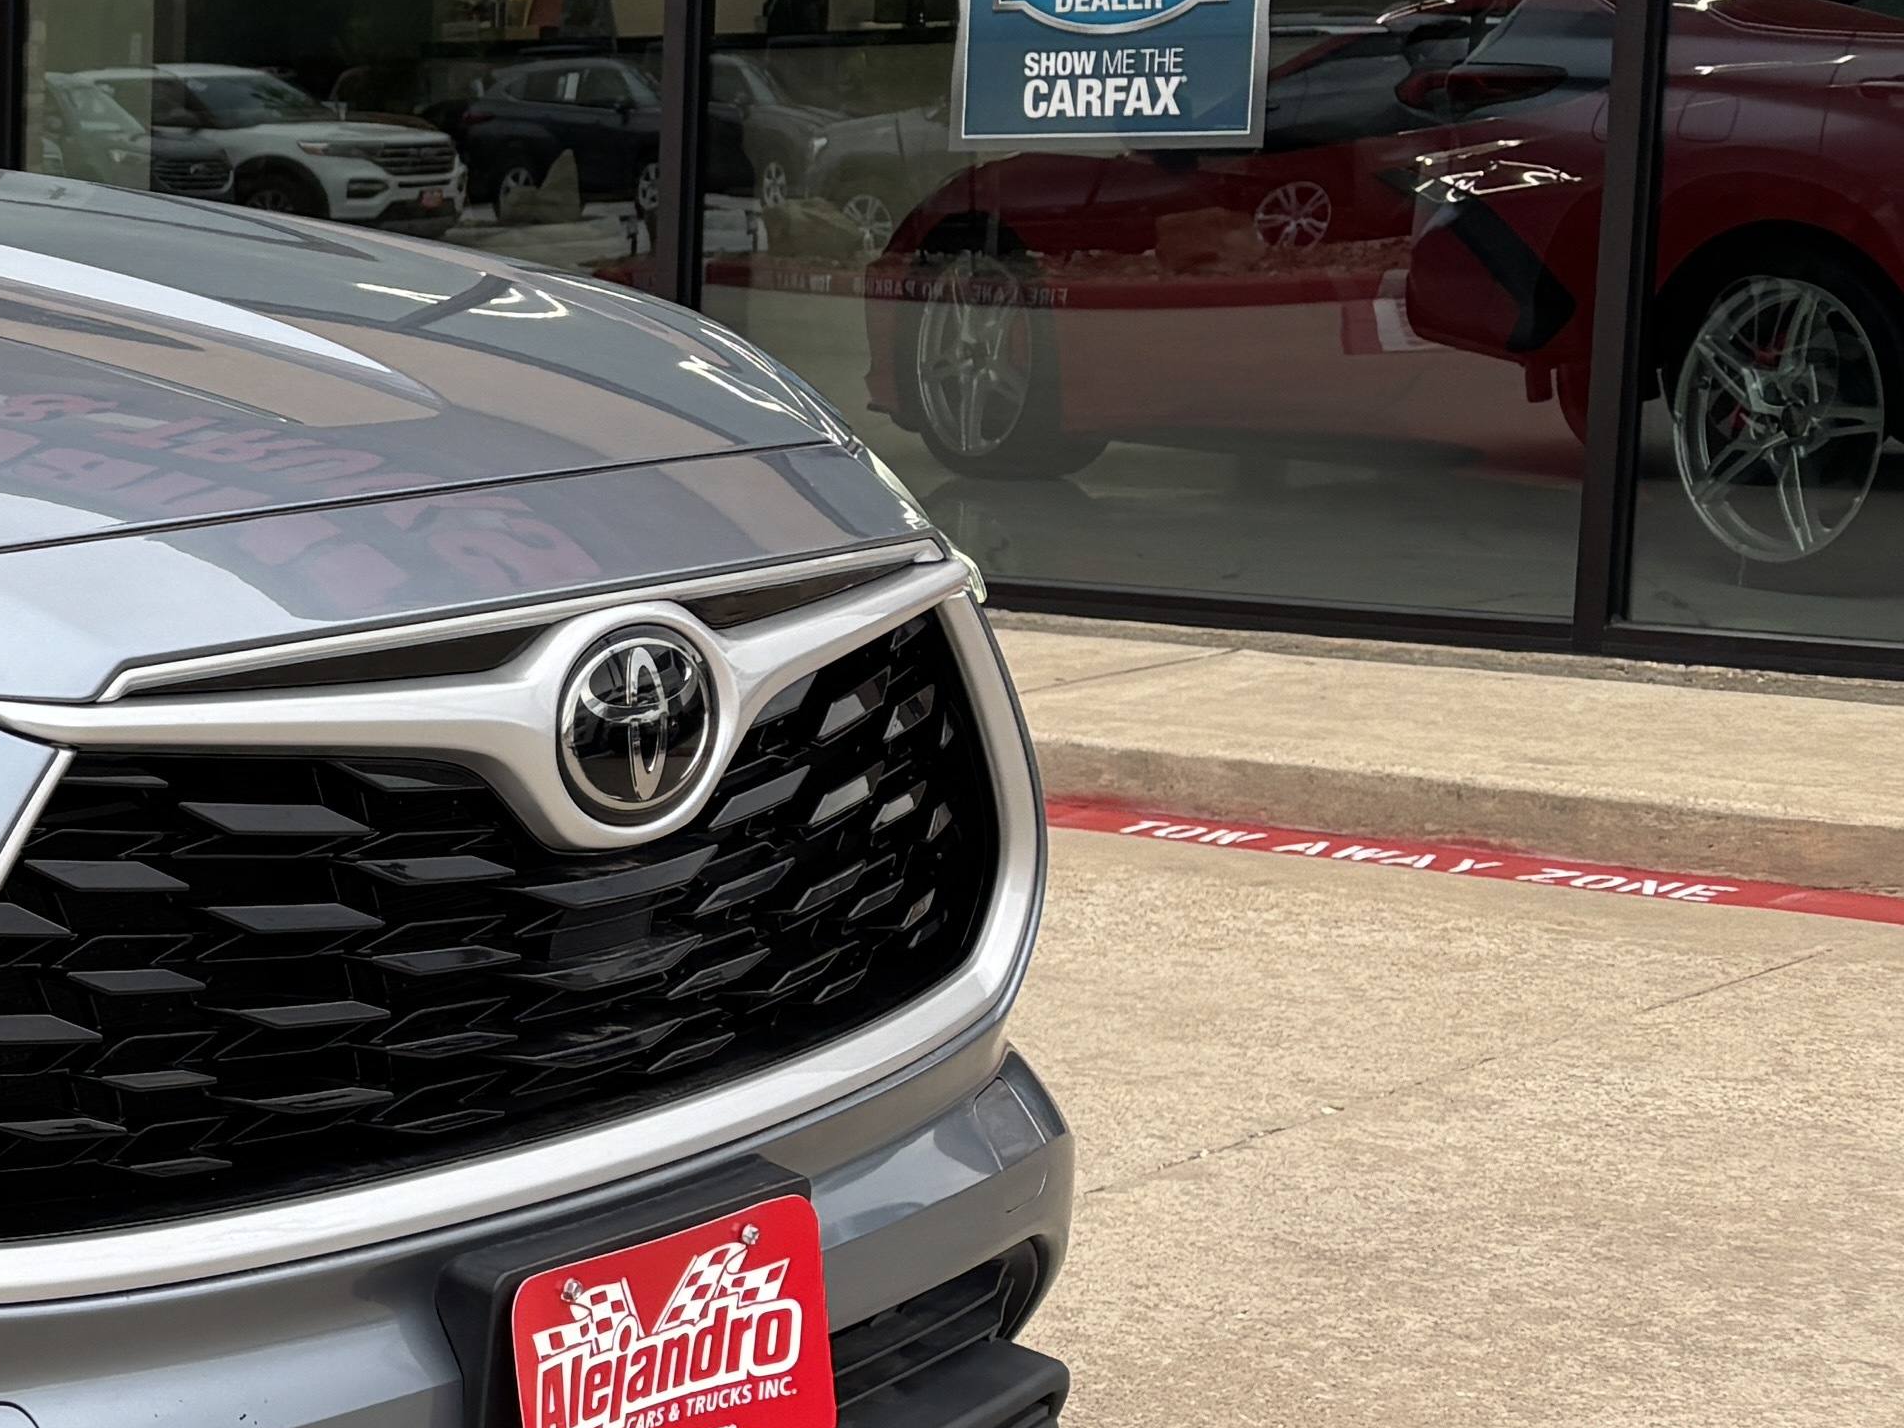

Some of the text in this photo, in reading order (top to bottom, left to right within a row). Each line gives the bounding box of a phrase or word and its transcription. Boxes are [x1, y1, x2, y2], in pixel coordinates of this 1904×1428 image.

[1023, 47, 1184, 77] SHOW ME THE
[1023, 77, 1181, 118] CARFAX
[1120, 819, 1739, 903] TOW AWAY ZONE
[668, 1403, 680, 1423] &
[686, 1384, 753, 1418] TRUCKS
[758, 1376, 798, 1400] INC.
